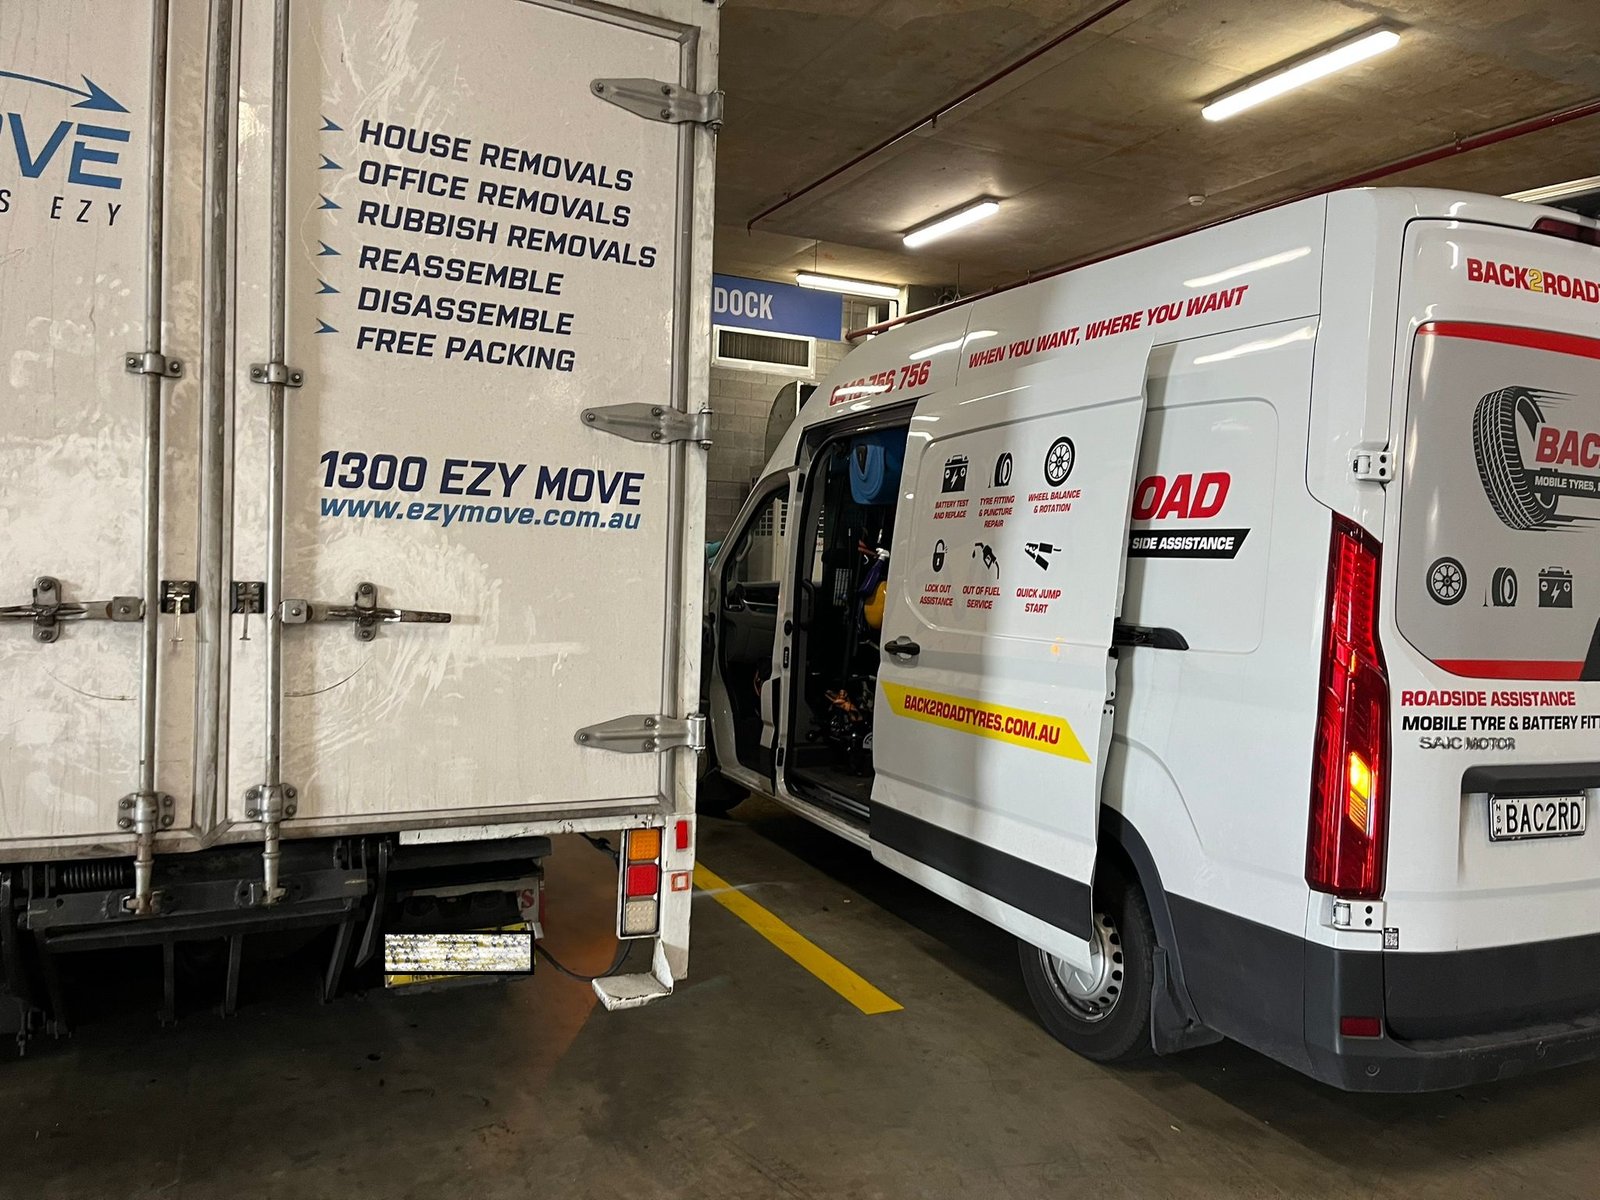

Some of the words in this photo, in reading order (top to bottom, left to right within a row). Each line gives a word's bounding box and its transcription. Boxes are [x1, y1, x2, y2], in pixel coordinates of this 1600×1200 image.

[0, 112, 131, 190] VE
[360, 119, 472, 162] HOUSE
[479, 143, 634, 192] REMOVALS
[358, 160, 469, 200] OFFICE
[477, 181, 631, 227] REMOVALS
[50, 196, 121, 226] EZY
[357, 200, 498, 244] RUBBISH
[507, 225, 657, 268] REMOVALS
[358, 245, 564, 295] REASSEMBLE
[357, 287, 574, 335] DISASSEMBLE
[714, 287, 773, 320] DOCK
[969, 346, 1004, 368] WHEN
[1008, 339, 1035, 359] YOU
[1037, 327, 1080, 353] WANT,
[1085, 311, 1143, 341] WHERE
[1146, 301, 1184, 326] YOU
[1186, 285, 1248, 317] WANT
[356, 326, 437, 357] FREE
[445, 336, 576, 372] PACKING
[899, 360, 931, 390] 756
[319, 450, 428, 492] 1300
[439, 459, 527, 498] EZY
[534, 465, 645, 505] MOVE
[1535, 476, 1567, 489] MOBILE
[1569, 479, 1596, 492] TYRES,
[980, 497, 993, 506] TYRE
[993, 495, 1015, 505] FITTING
[1028, 492, 1049, 502] WHEEL
[1050, 489, 1081, 500] BALANCE
[935, 499, 956, 509] BATTERY
[956, 499, 969, 507] TEST
[978, 509, 983, 517] &
[984, 507, 1013, 517] PUNCTURE
[1033, 506, 1038, 514] &
[1039, 503, 1071, 513] ROTATION
[320, 498, 640, 530] www.ezymove.com.au
[933, 511, 945, 520] AND
[945, 510, 967, 519] REPLACE
[984, 520, 1004, 528] REPAIR
[1132, 537, 1158, 550] SIDE
[1158, 537, 1235, 550] ASSISTANCE
[925, 583, 939, 593] LOCK
[939, 584, 951, 593] OUT
[962, 585, 976, 595] OUT
[976, 585, 984, 595] OF
[984, 586, 1000, 596] FUEL
[1016, 588, 1038, 599] QUICK
[1039, 588, 1061, 599] JUMP
[919, 596, 954, 607] ASSISTANCE
[966, 599, 993, 609] SERVICE
[1025, 603, 1049, 614] START
[1401, 690, 1486, 706] ROADSIDE
[1491, 691, 1576, 706] ASSISTANCE
[904, 694, 1061, 744] BACK2ROADTYRES.COM.AU
[1402, 716, 1466, 730] MOBILE
[1471, 716, 1505, 730] TYRE
[1509, 716, 1519, 730] &
[1522, 716, 1578, 730] BATTERY
[1419, 736, 1462, 750] SAIC
[1464, 737, 1516, 750] MOTOR
[1506, 802, 1580, 833] BAC2RD
